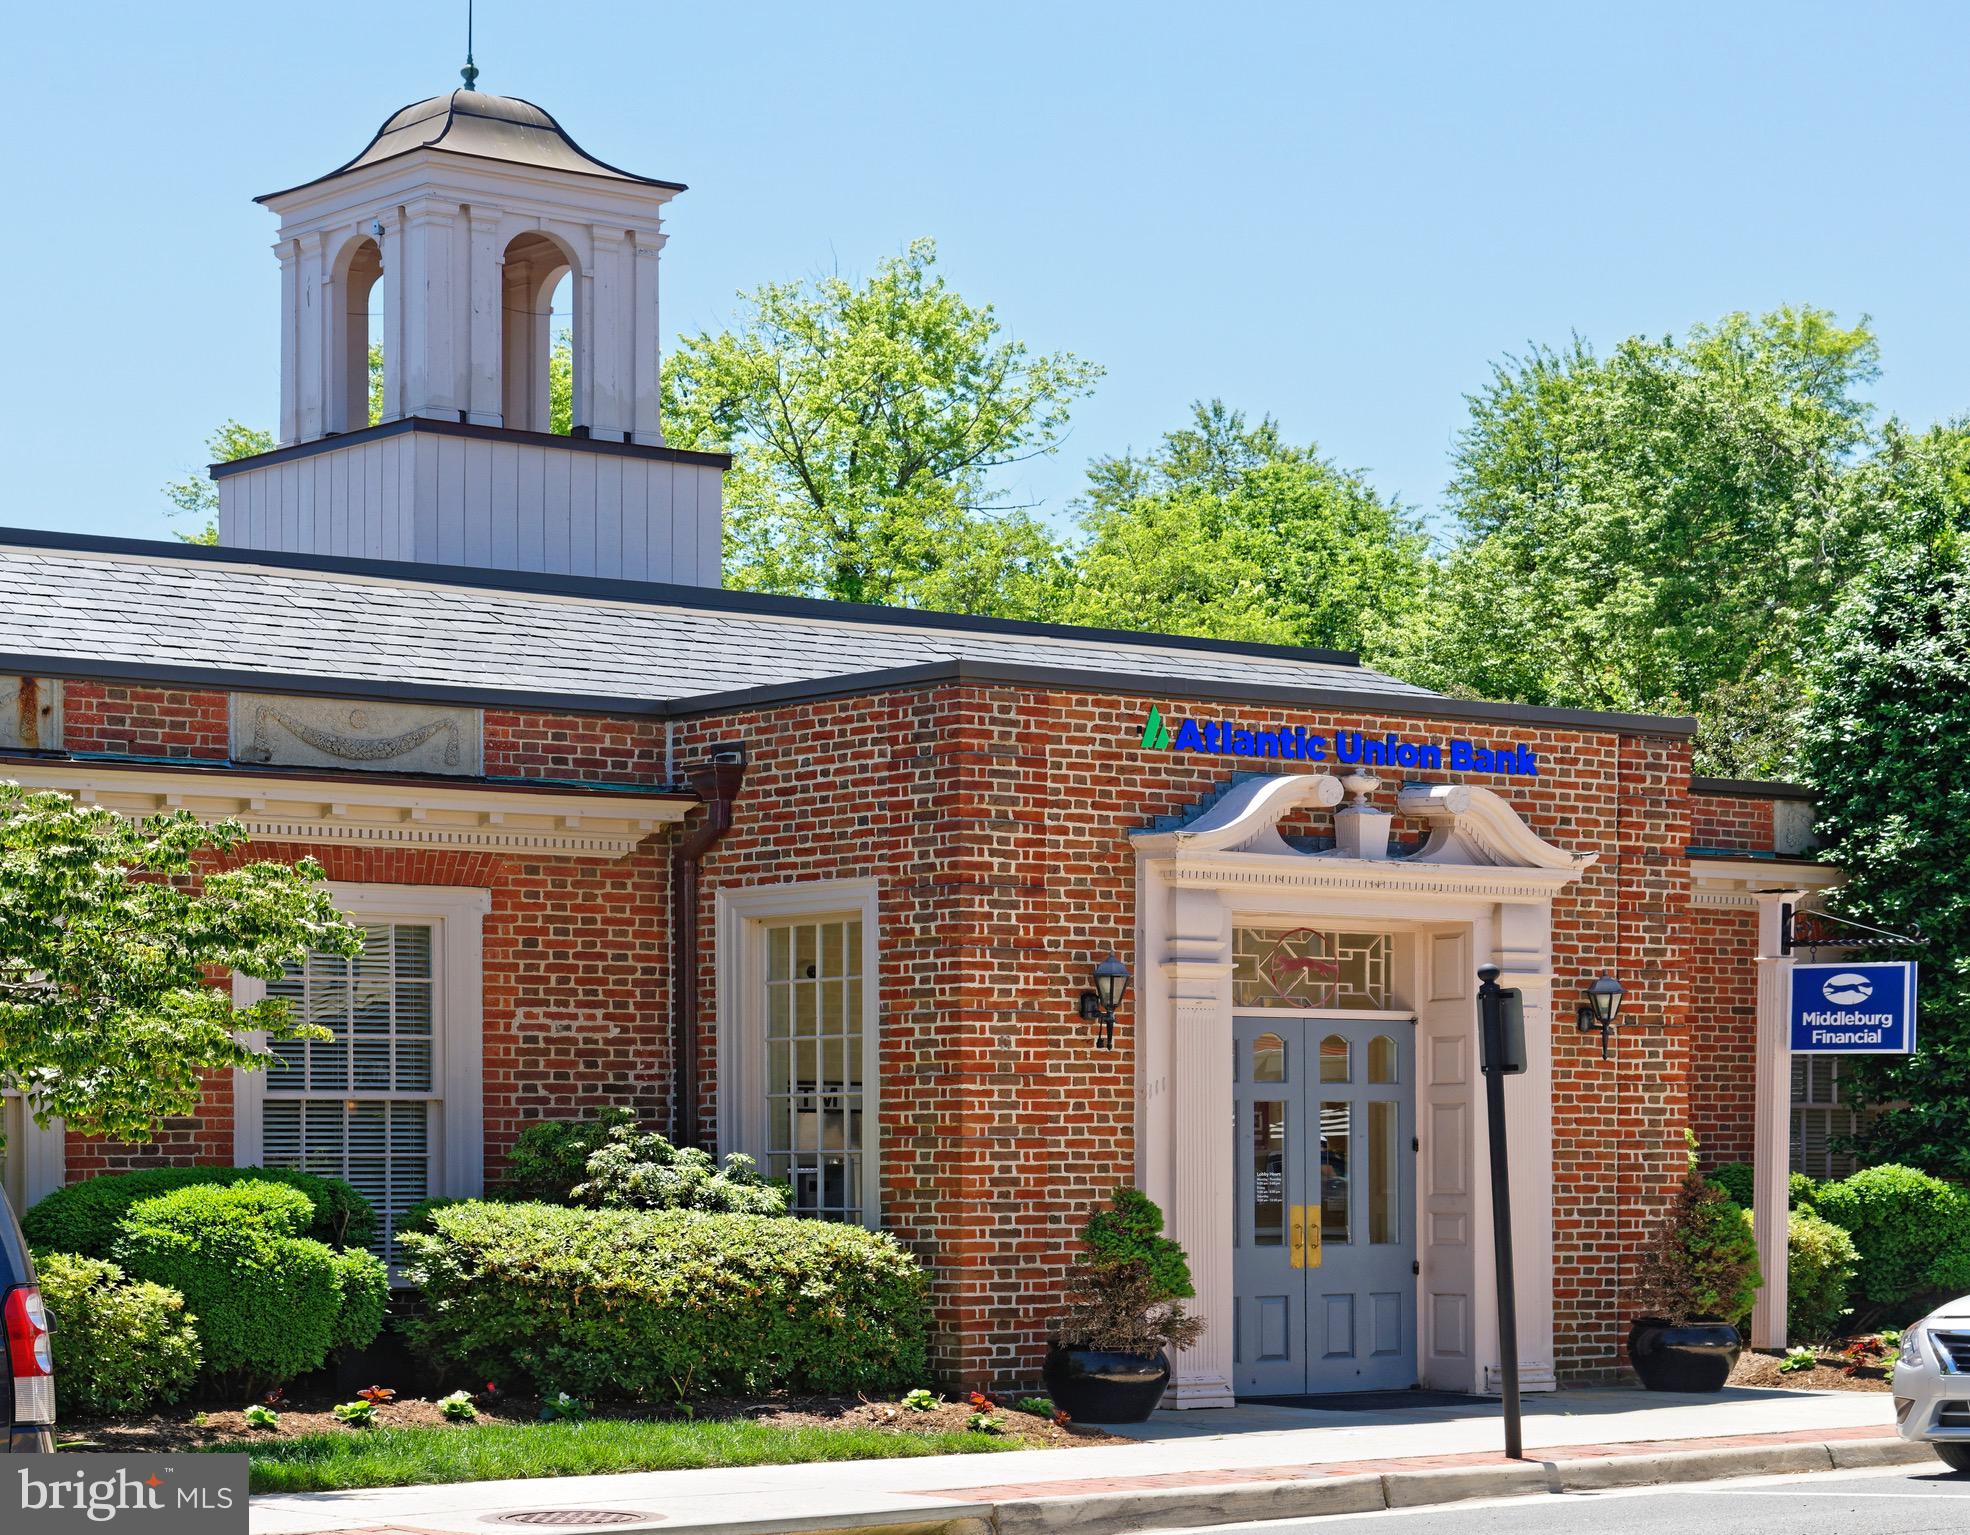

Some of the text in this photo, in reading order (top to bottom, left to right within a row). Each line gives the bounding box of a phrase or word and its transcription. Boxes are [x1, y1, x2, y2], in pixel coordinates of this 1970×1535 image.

[1174, 718, 1539, 776] Atlantic Union Bank
[1802, 1011, 1893, 1028] Middleburg
[1812, 1029, 1882, 1044] Financial
[787, 1086, 838, 1107] TM
